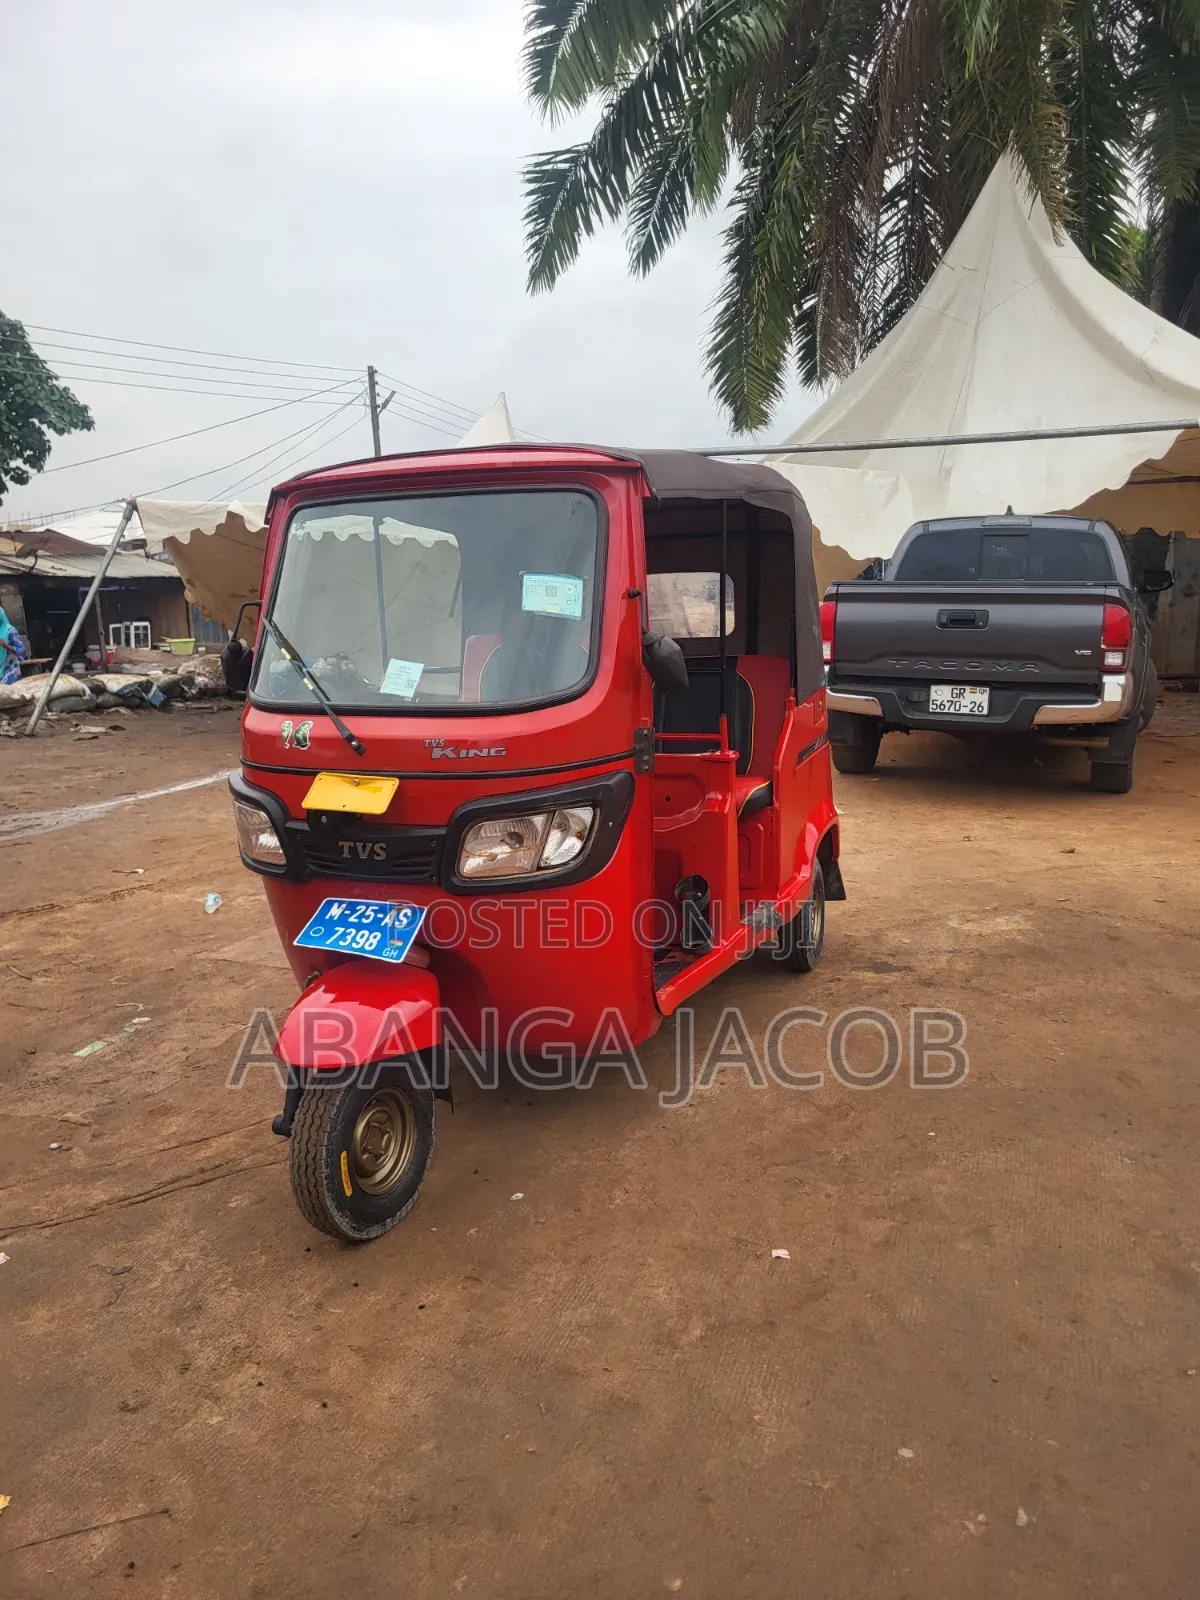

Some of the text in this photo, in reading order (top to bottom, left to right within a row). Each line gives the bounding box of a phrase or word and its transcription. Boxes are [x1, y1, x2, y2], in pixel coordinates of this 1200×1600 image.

[887, 657, 1040, 673] TACOMA
[951, 687, 966, 699] GR
[931, 699, 984, 713] 5670-26
[424, 739, 445, 748] TVS
[338, 841, 387, 860] TVS
[325, 902, 412, 928] M-25-AS
[325, 927, 381, 950] 7398
[382, 947, 399, 959] GH
